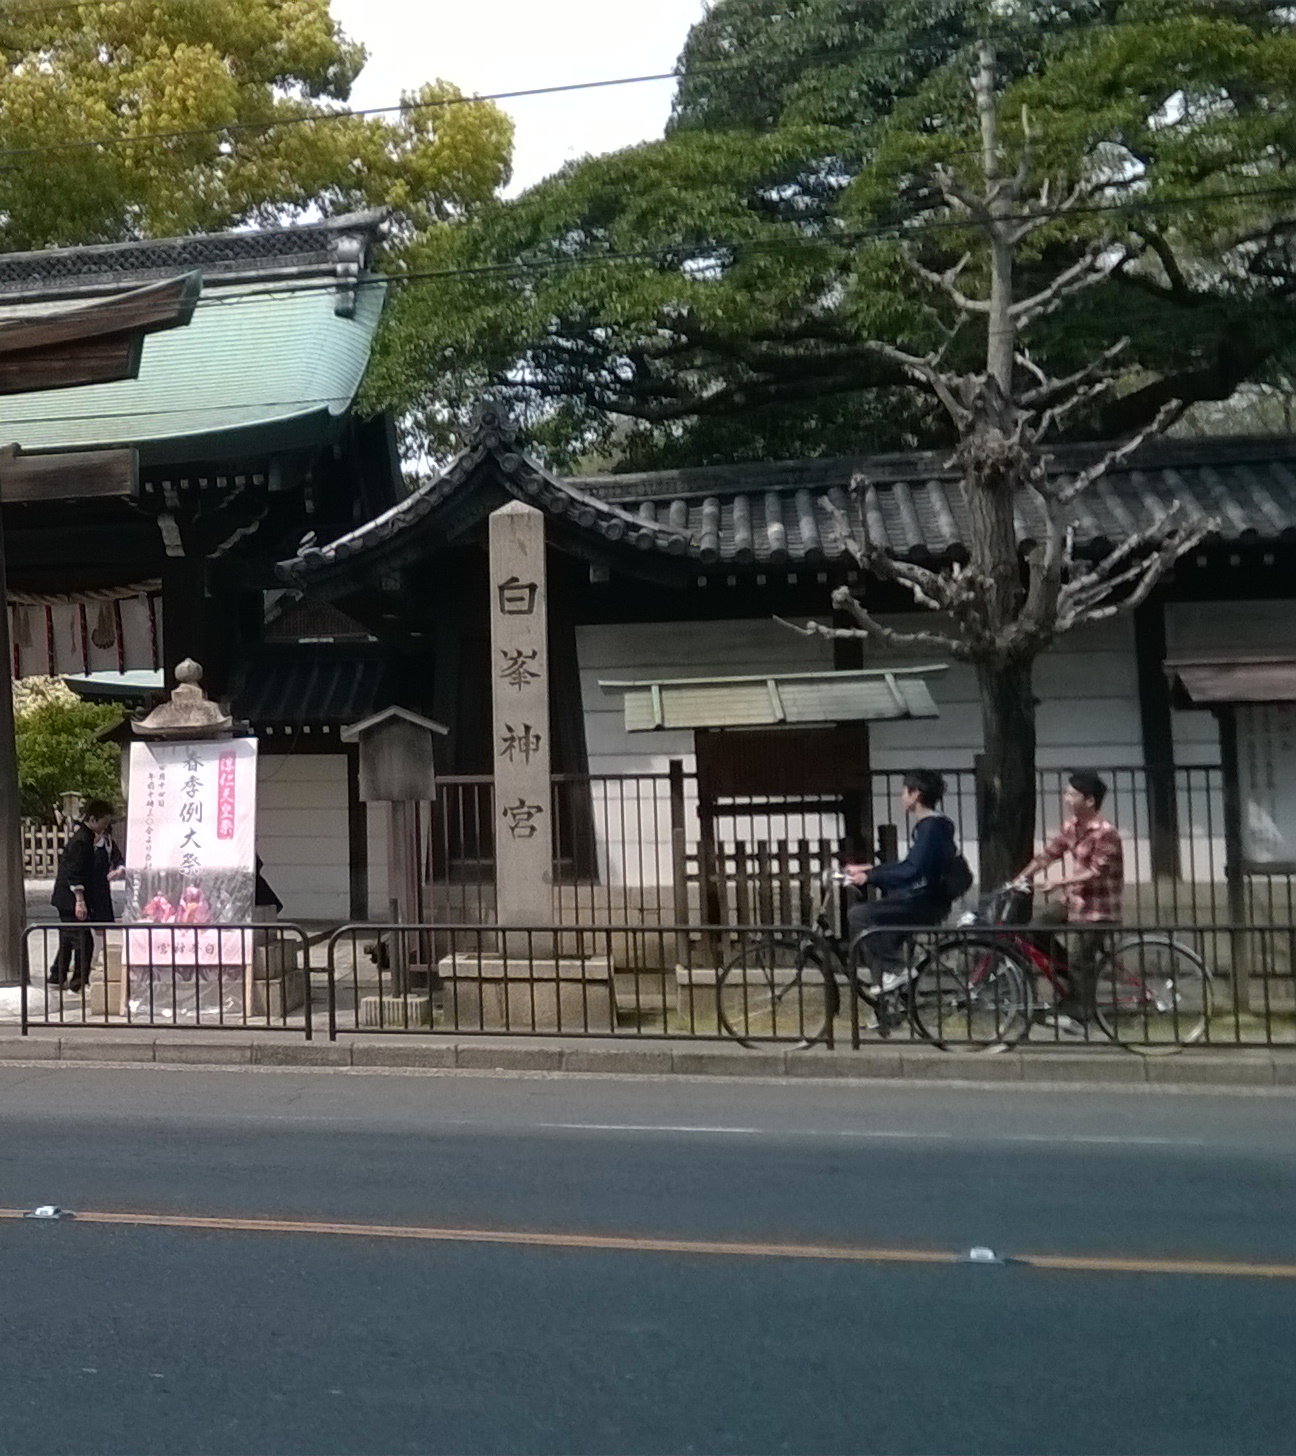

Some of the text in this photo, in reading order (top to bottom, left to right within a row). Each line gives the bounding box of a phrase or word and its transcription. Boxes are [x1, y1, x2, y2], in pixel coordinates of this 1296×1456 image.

[497, 576, 544, 841] 白峯神宮
[179, 749, 205, 877] 春季例大祭
